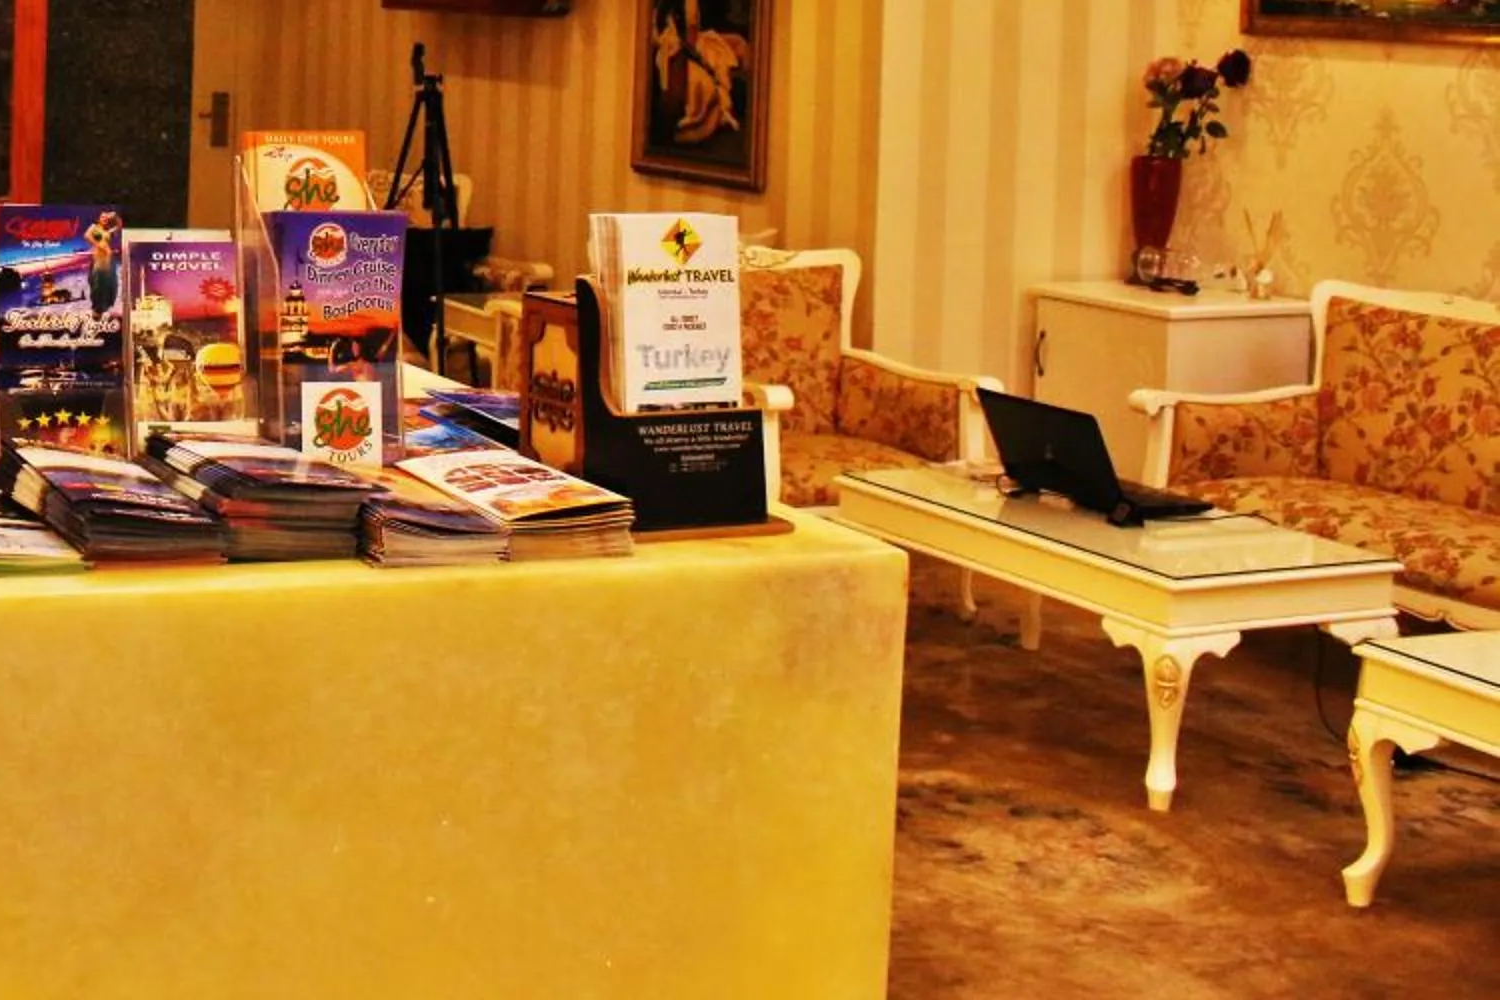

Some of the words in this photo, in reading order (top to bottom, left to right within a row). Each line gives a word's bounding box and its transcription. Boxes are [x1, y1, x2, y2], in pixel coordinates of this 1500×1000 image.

[151, 251, 222, 261] DIMPLE
[149, 261, 222, 274] TRAVEL
[352, 258, 397, 278] Cruise
[684, 269, 736, 283] TRAVEL
[375, 275, 396, 293] the
[636, 343, 731, 374] Turkey
[638, 423, 711, 436] WANDERLUST
[713, 420, 754, 433] TRAVEL
[329, 440, 373, 463] TOURS
